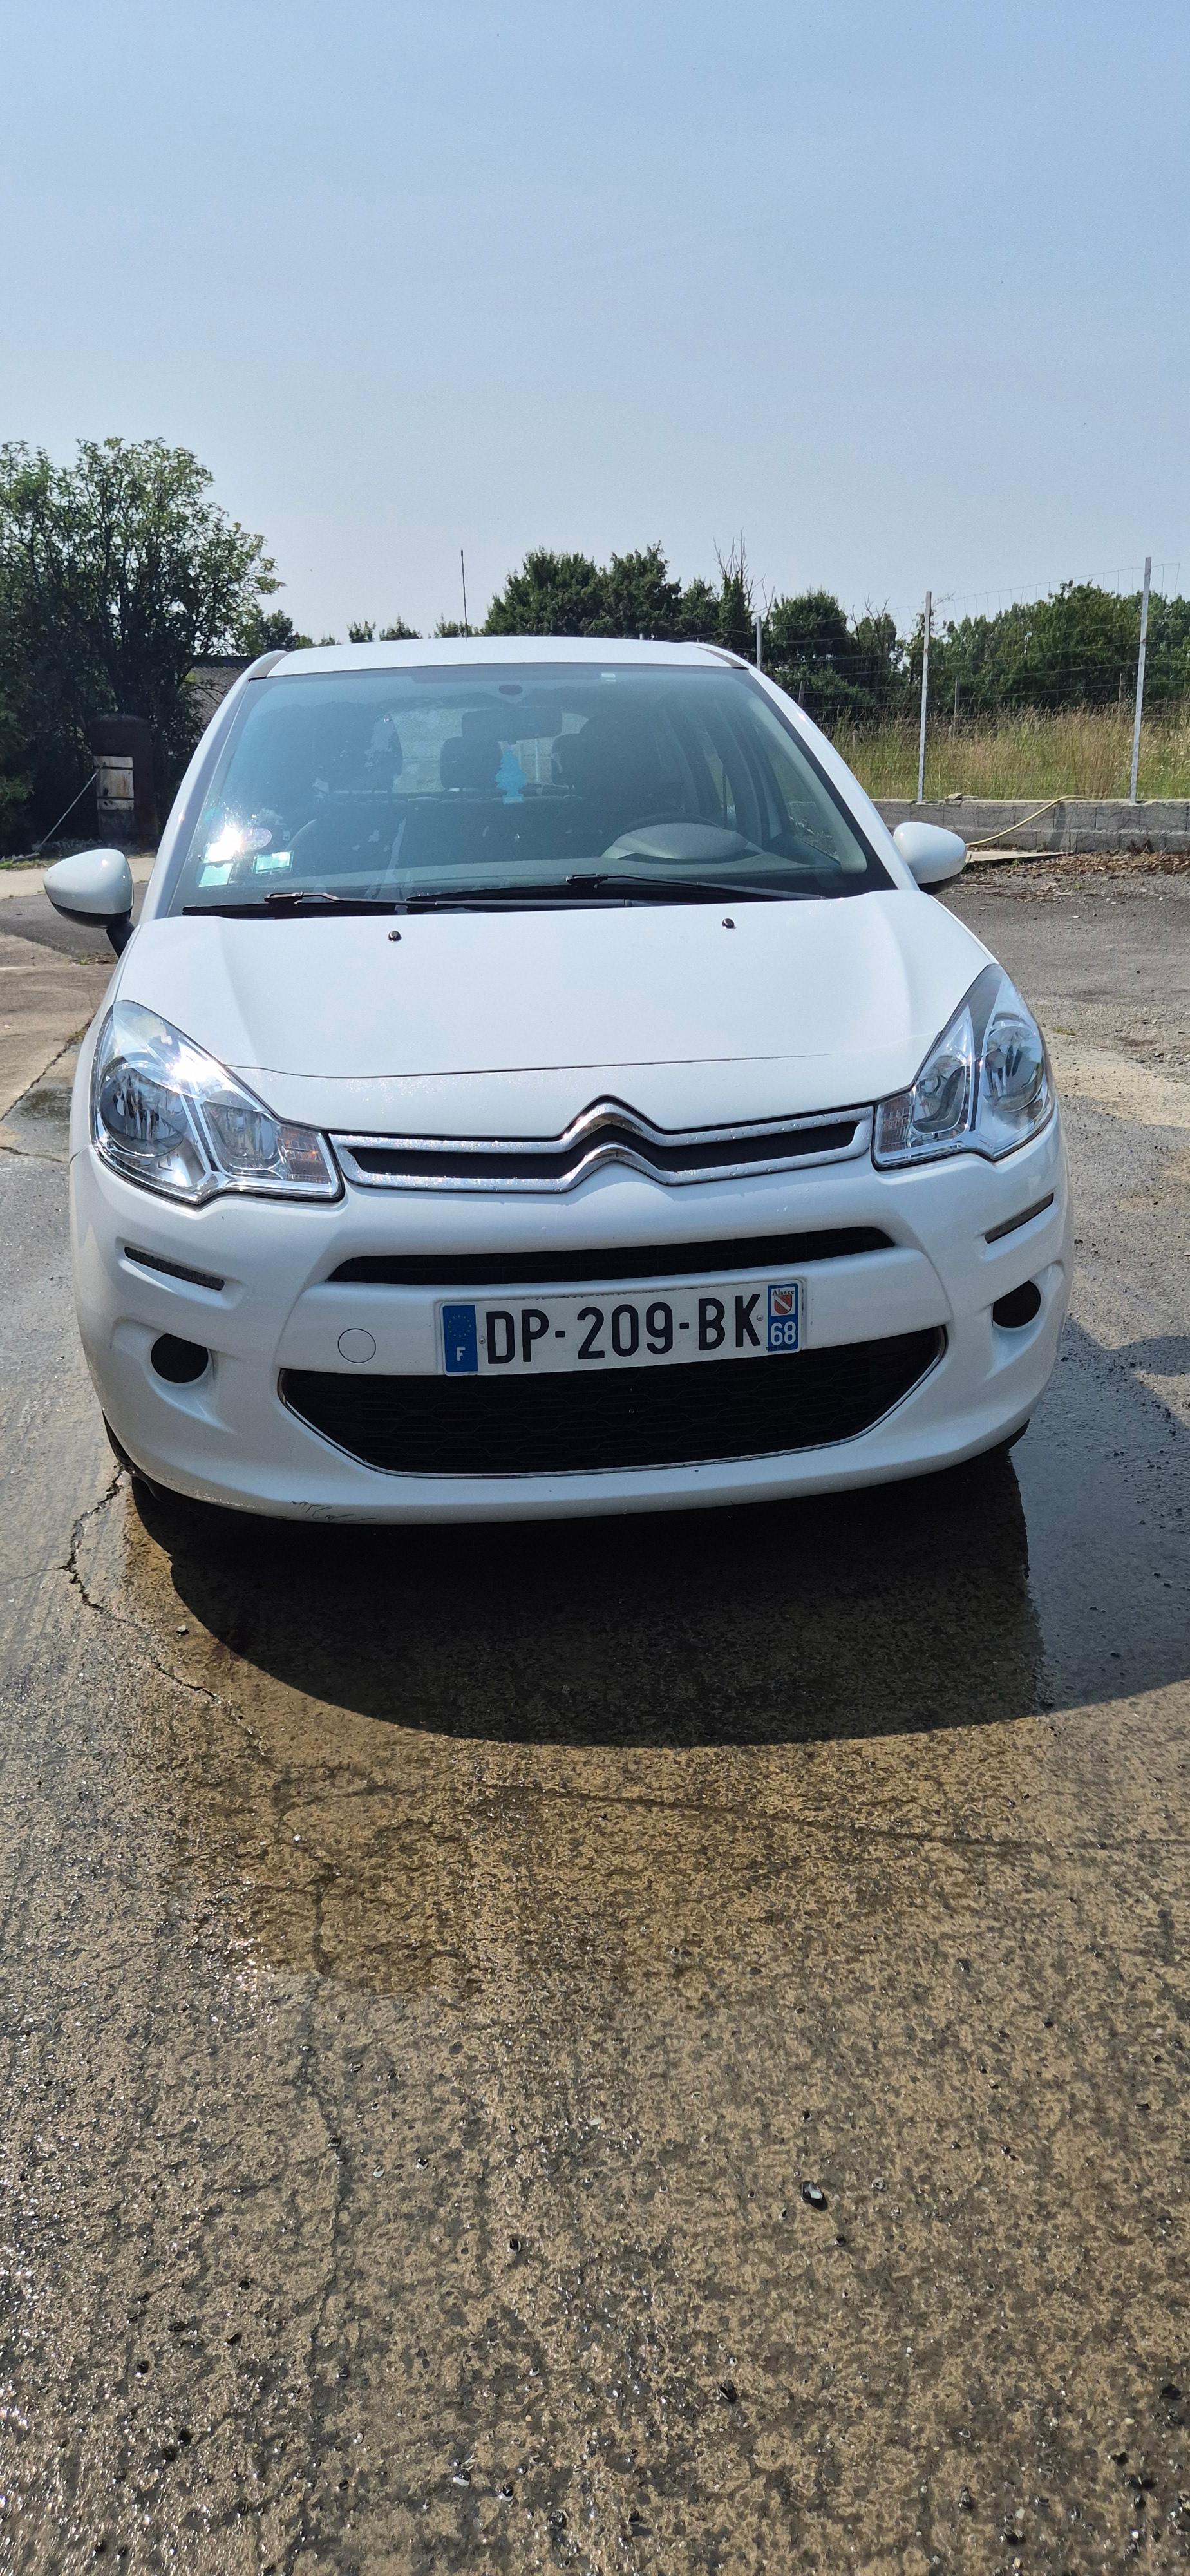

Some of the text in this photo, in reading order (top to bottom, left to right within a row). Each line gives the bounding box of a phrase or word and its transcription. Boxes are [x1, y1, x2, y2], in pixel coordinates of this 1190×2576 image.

[486, 1293, 761, 1364] DP-209-BK
[771, 1321, 796, 1346] 68
[456, 1347, 466, 1361] F
